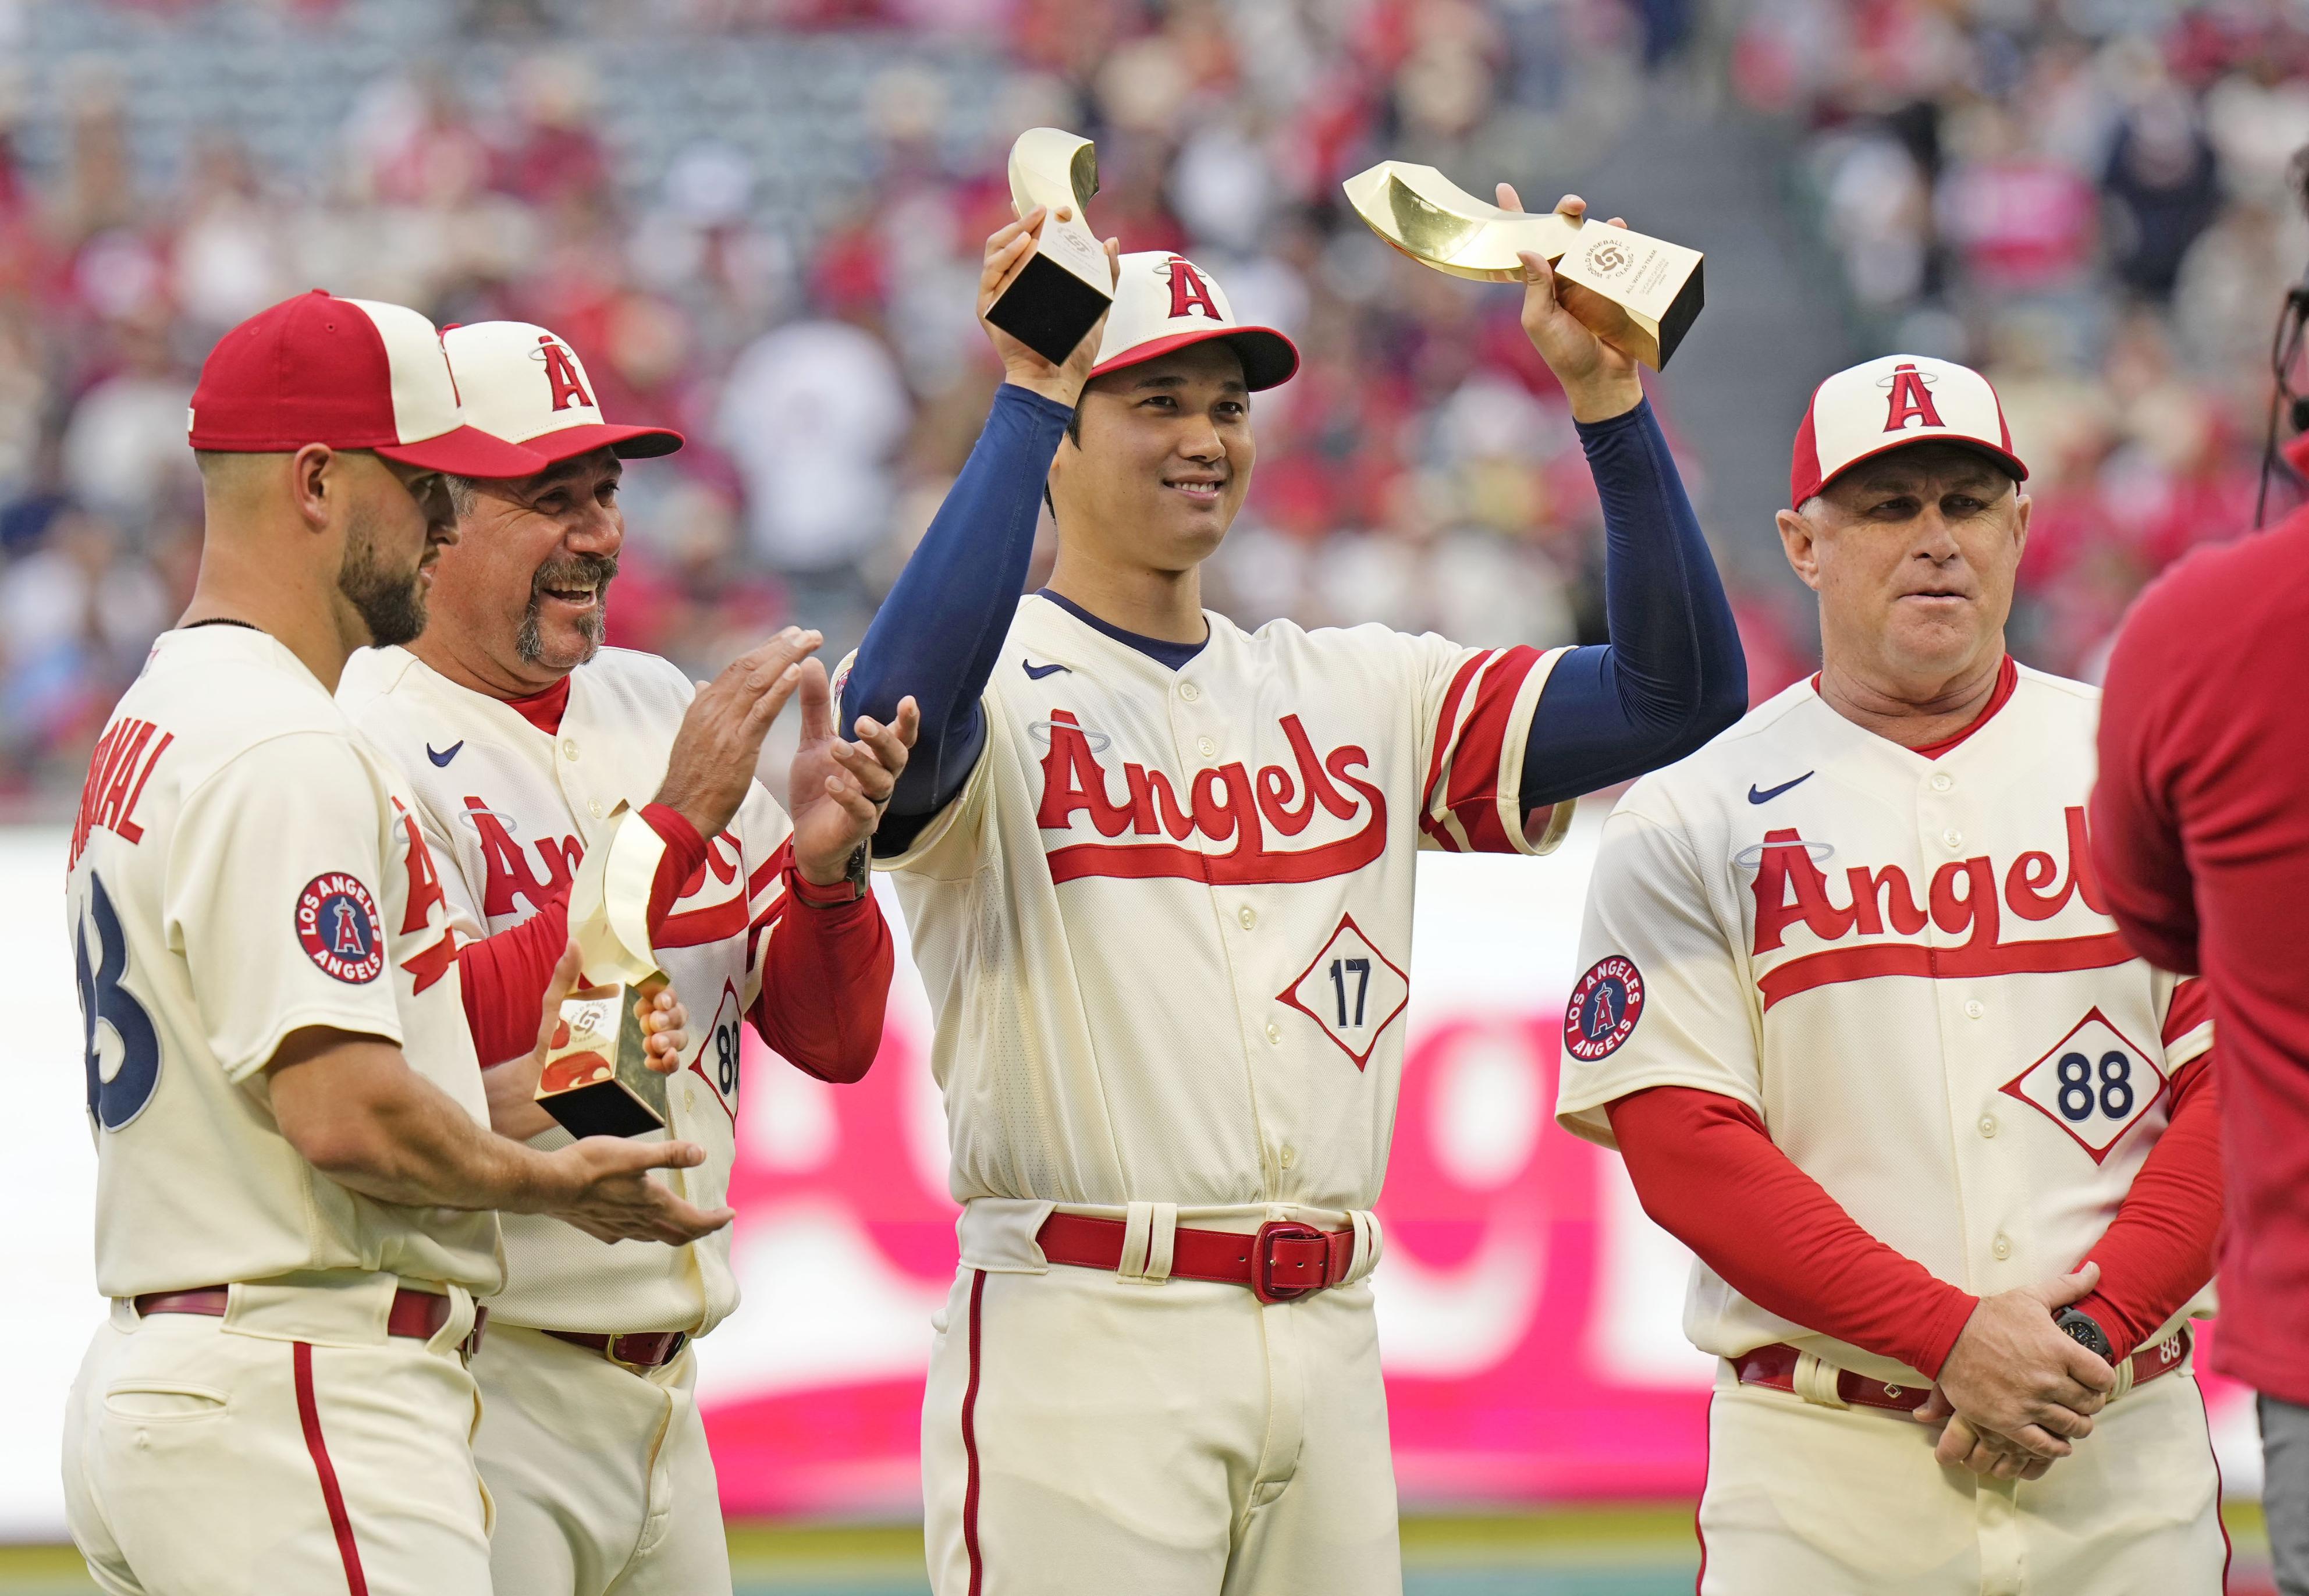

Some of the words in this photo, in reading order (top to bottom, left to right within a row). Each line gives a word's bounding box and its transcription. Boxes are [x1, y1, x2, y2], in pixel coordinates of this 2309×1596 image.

[1585, 258, 1603, 279] WORLD
[1586, 239, 1623, 257] BASEBALL
[1615, 253, 1634, 278] CLASSIC
[1632, 265, 1647, 284] WORLD
[1646, 250, 1657, 265] TEAM
[1166, 257, 1223, 321] A
[538, 336, 583, 412] A
[1882, 364, 1946, 433] A
[1036, 709, 1387, 886] Angels
[299, 893, 320, 936] LOS
[318, 876, 382, 943] ANGELES
[1749, 806, 2130, 1010] Angel
[313, 949, 381, 980] ANGELS
[1329, 959, 1371, 1028] 17
[1567, 993, 1585, 1033] LOS
[1586, 960, 1640, 1005] ANGELES
[1572, 1019, 1632, 1057] ANGELS
[2056, 1051, 2134, 1123] 88
[2160, 1333, 2180, 1364] 88
